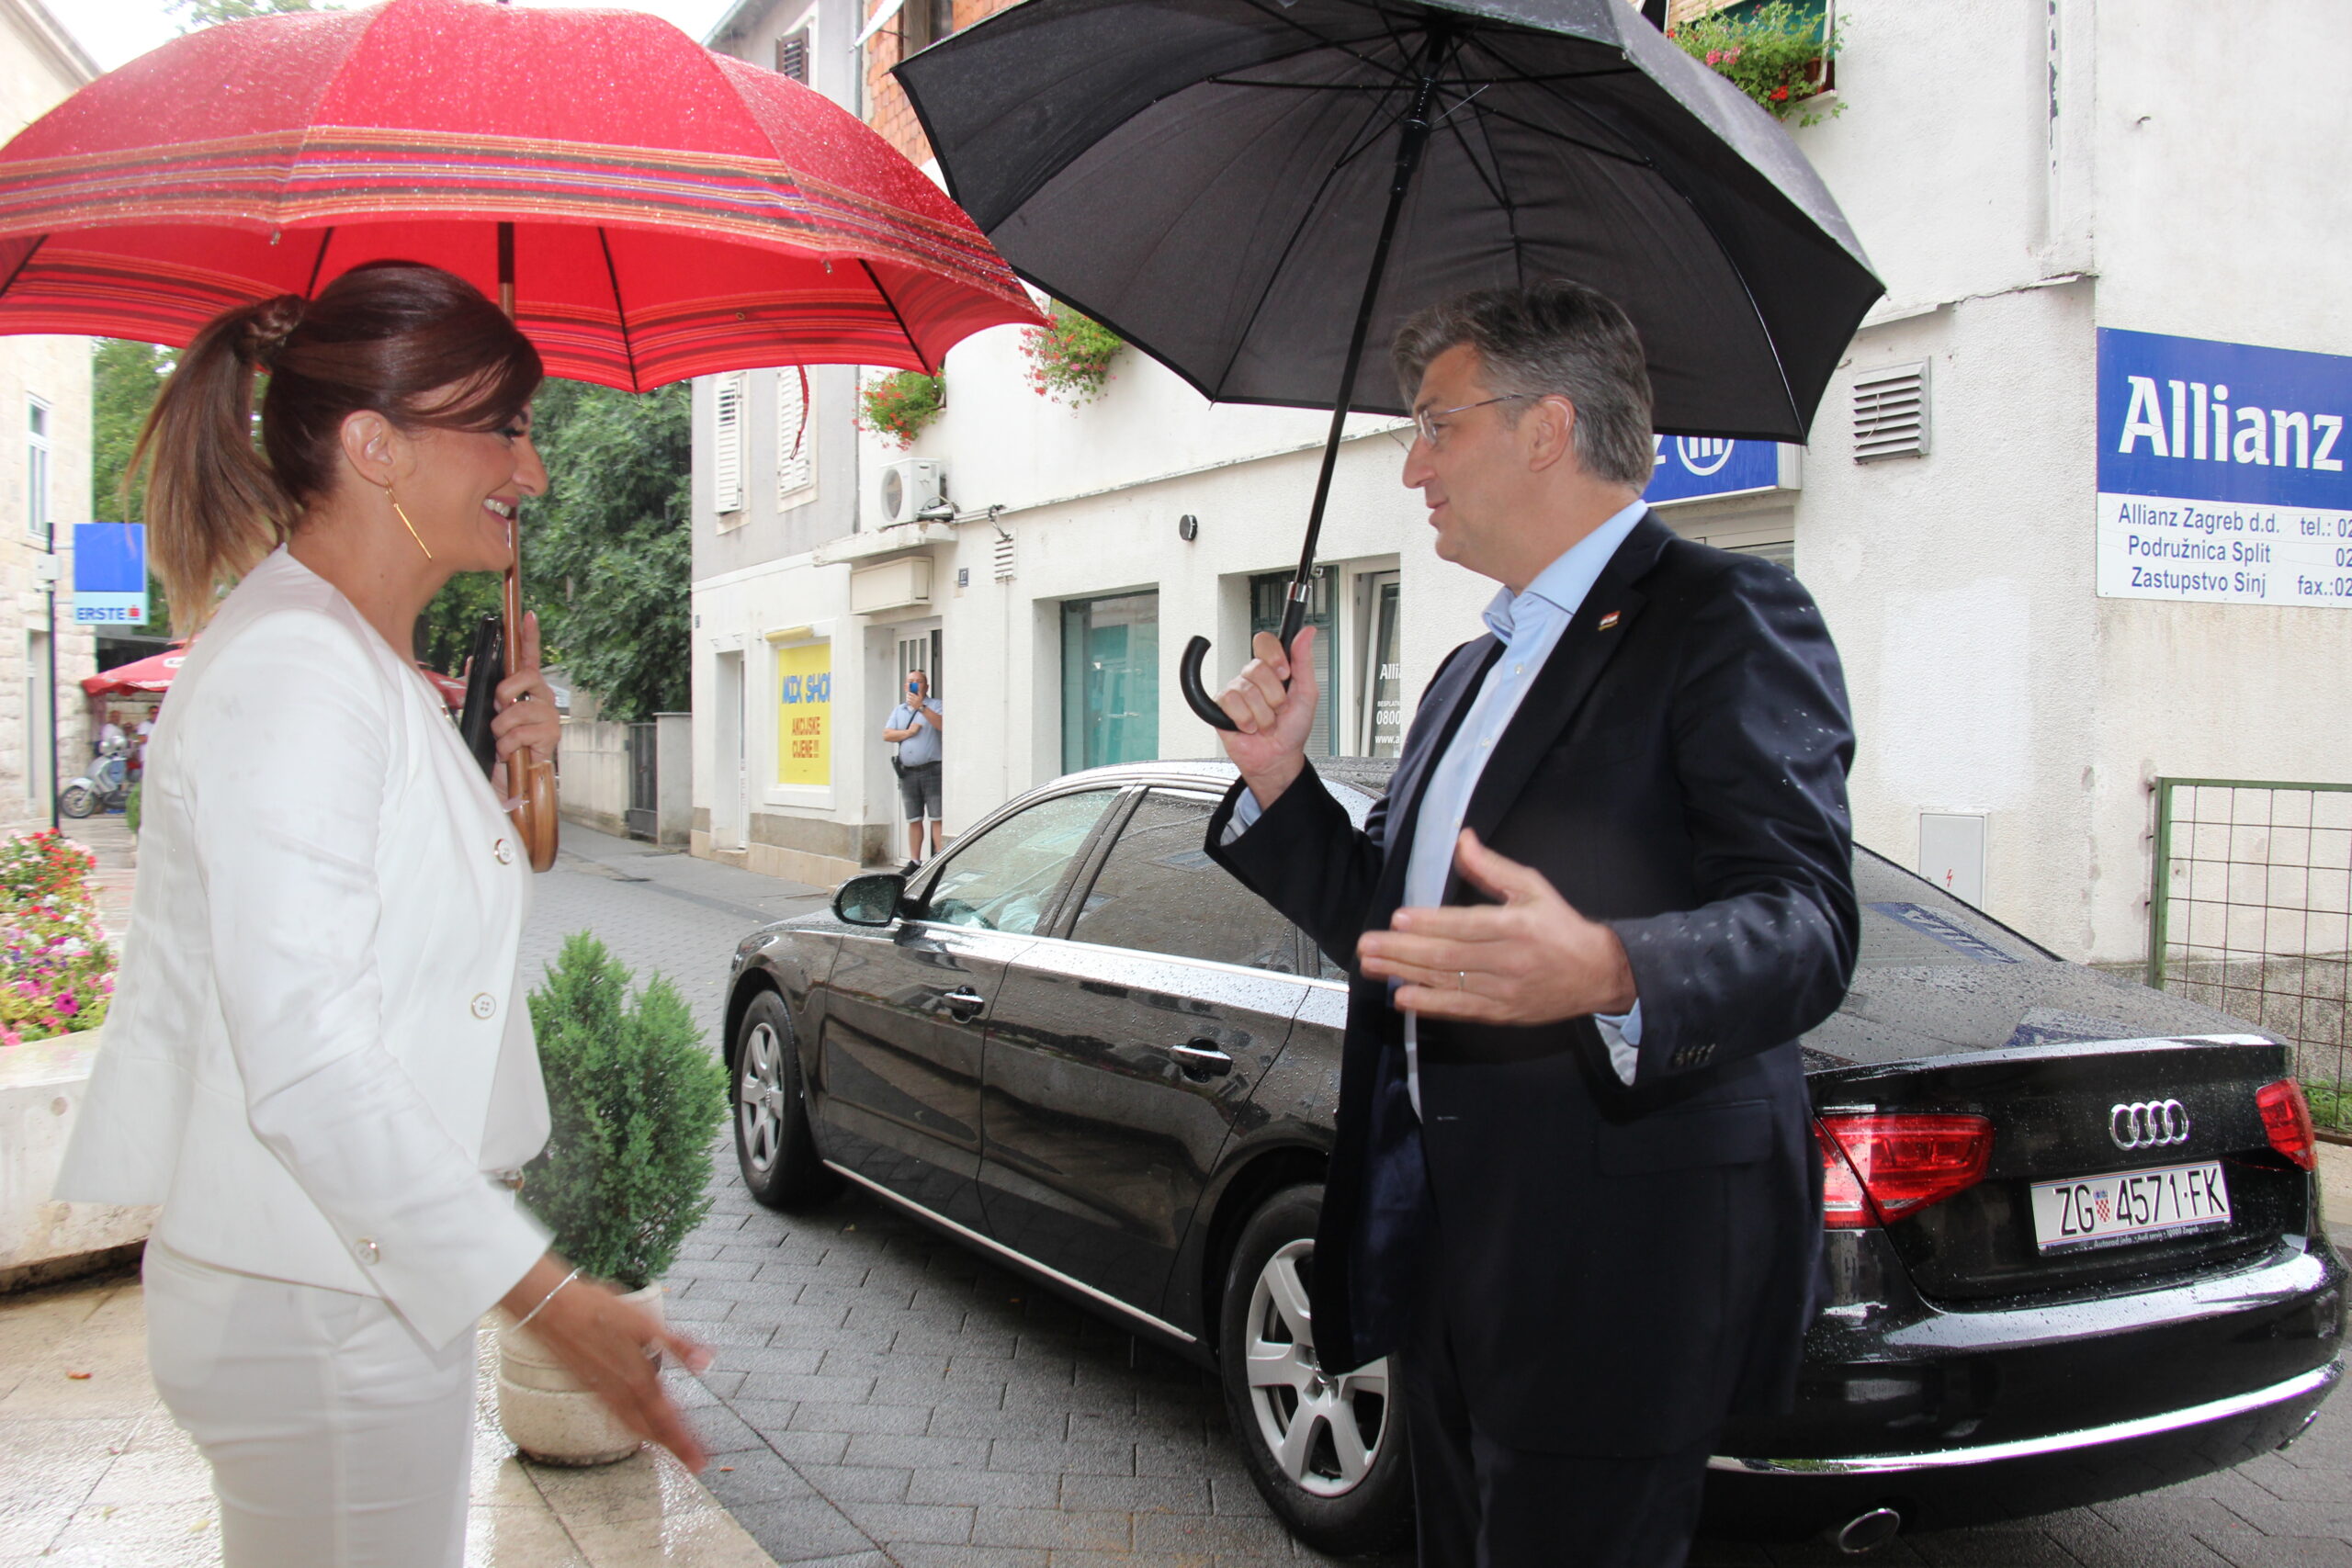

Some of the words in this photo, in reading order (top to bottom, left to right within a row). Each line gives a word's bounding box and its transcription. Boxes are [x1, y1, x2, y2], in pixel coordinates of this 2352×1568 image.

[2118, 375, 2343, 471] Allianz
[2118, 503, 2177, 527] Allianz
[2183, 507, 2244, 535] Zagreb
[2249, 512, 2280, 534] d.d.
[2128, 535, 2226, 560] Podružnica
[2232, 540, 2271, 567] Split
[2132, 567, 2229, 594] Zastupstvo
[2233, 571, 2267, 598] Sinj
[76, 607, 125, 620] ERSTE
[1379, 663, 1401, 680] Alli
[1376, 710, 1400, 725] 0800
[2052, 1184, 2095, 1236] ZG
